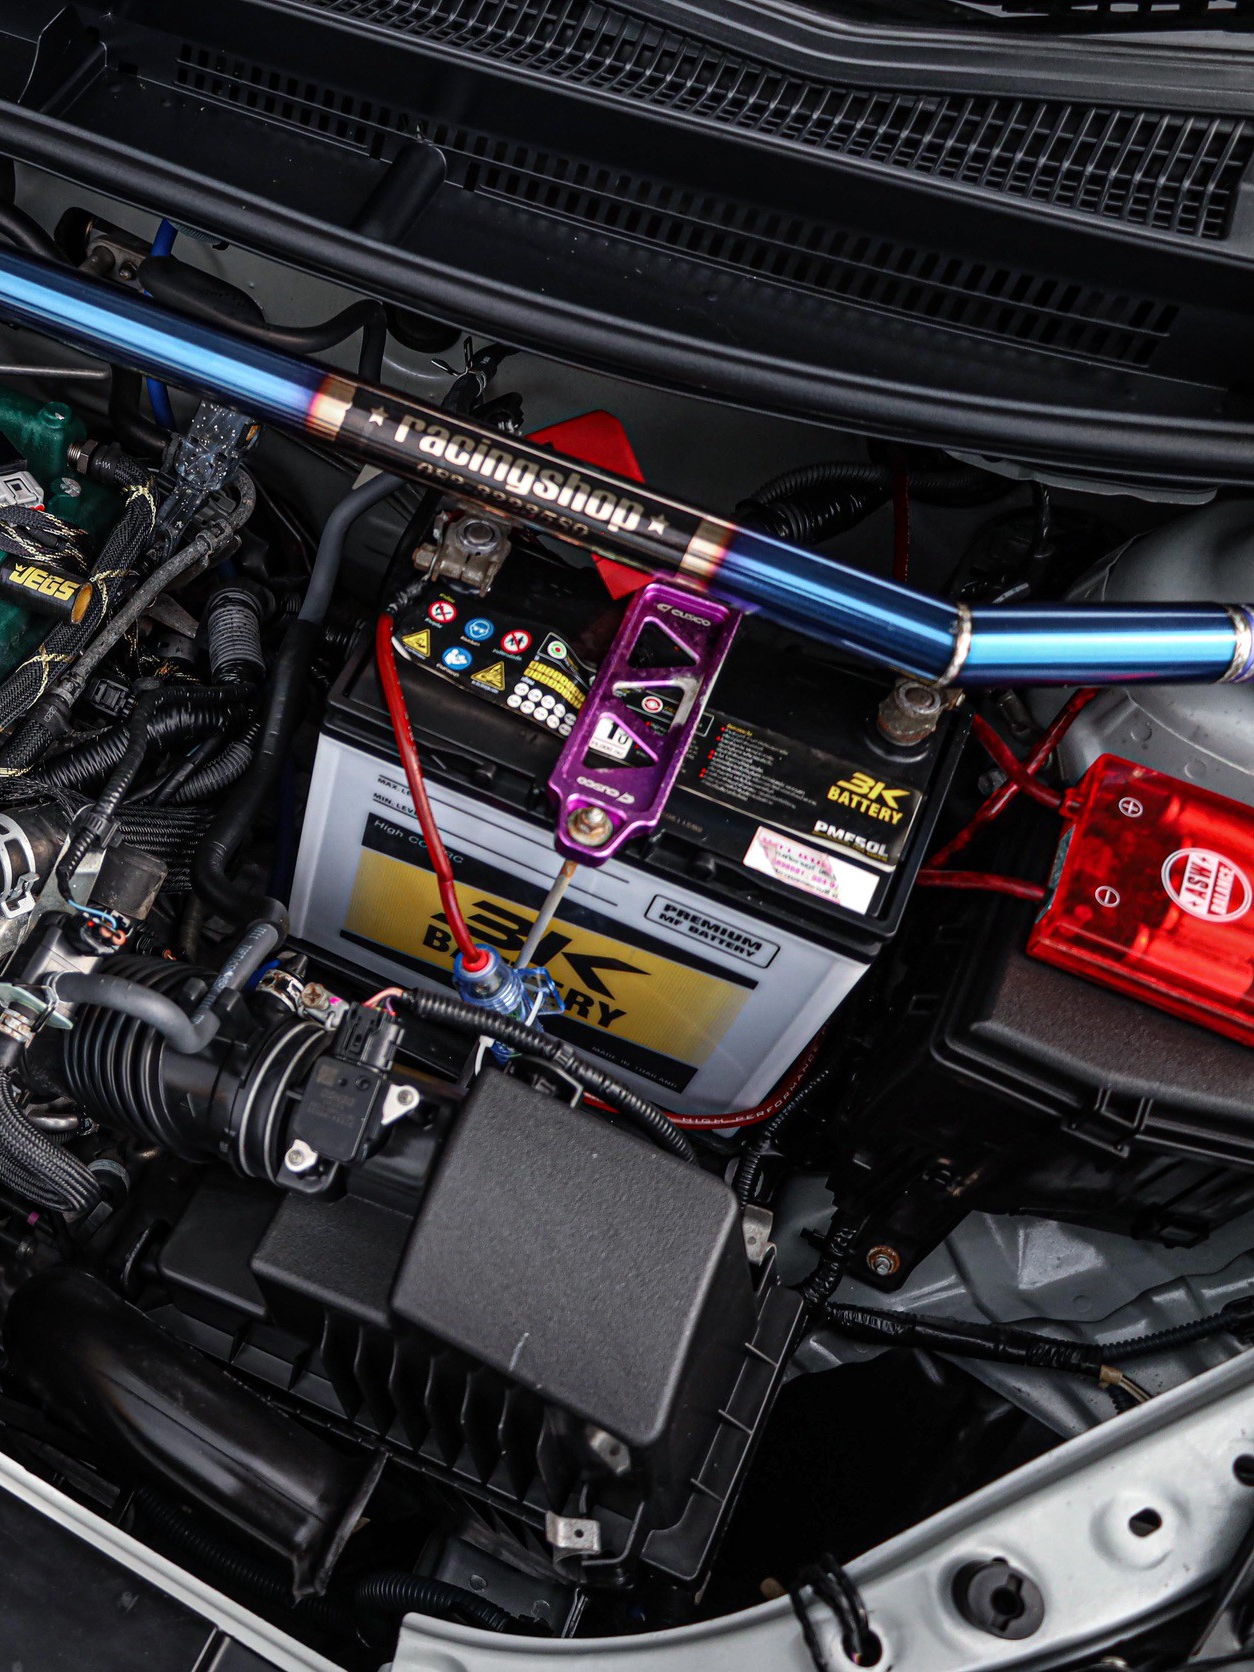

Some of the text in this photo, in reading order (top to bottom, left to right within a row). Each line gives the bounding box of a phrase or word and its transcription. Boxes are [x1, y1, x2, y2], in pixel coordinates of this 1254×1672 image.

[393, 413, 645, 533] racingshop
[9, 566, 81, 601] JEGS
[373, 793, 394, 806] MIN.
[377, 778, 400, 792] MAX.
[836, 771, 911, 810] 3K
[827, 785, 903, 825] BATTERY
[373, 819, 405, 839] High
[1185, 861, 1212, 900] ASW
[659, 912, 757, 958] MF BATTERY
[664, 903, 762, 952] PREMIUM
[590, 1046, 678, 1089] MADE IN THAILAND
[681, 1047, 820, 1125] HIGH PERFORMANCE
